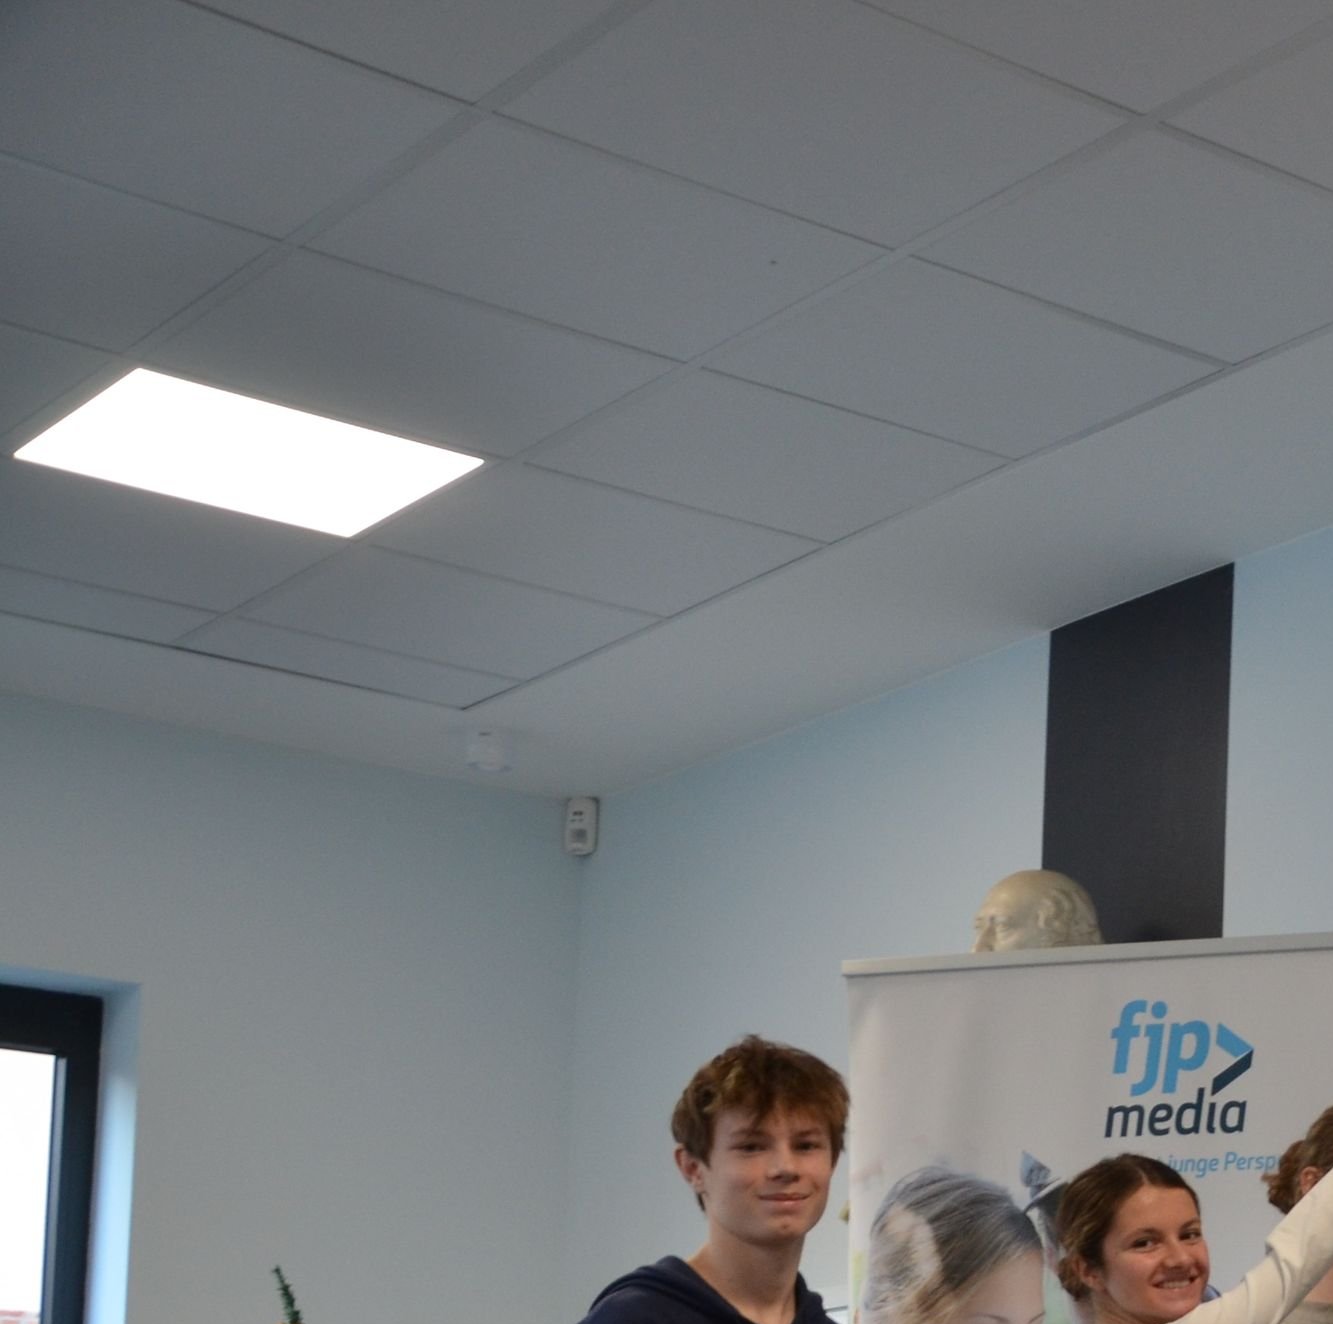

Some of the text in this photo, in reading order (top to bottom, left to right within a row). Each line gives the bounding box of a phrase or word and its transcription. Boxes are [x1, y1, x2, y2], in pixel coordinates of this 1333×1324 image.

[1110, 999, 1211, 1097] fjp
[1104, 1087, 1247, 1138] media
[1224, 1151, 1279, 1175] Persp
